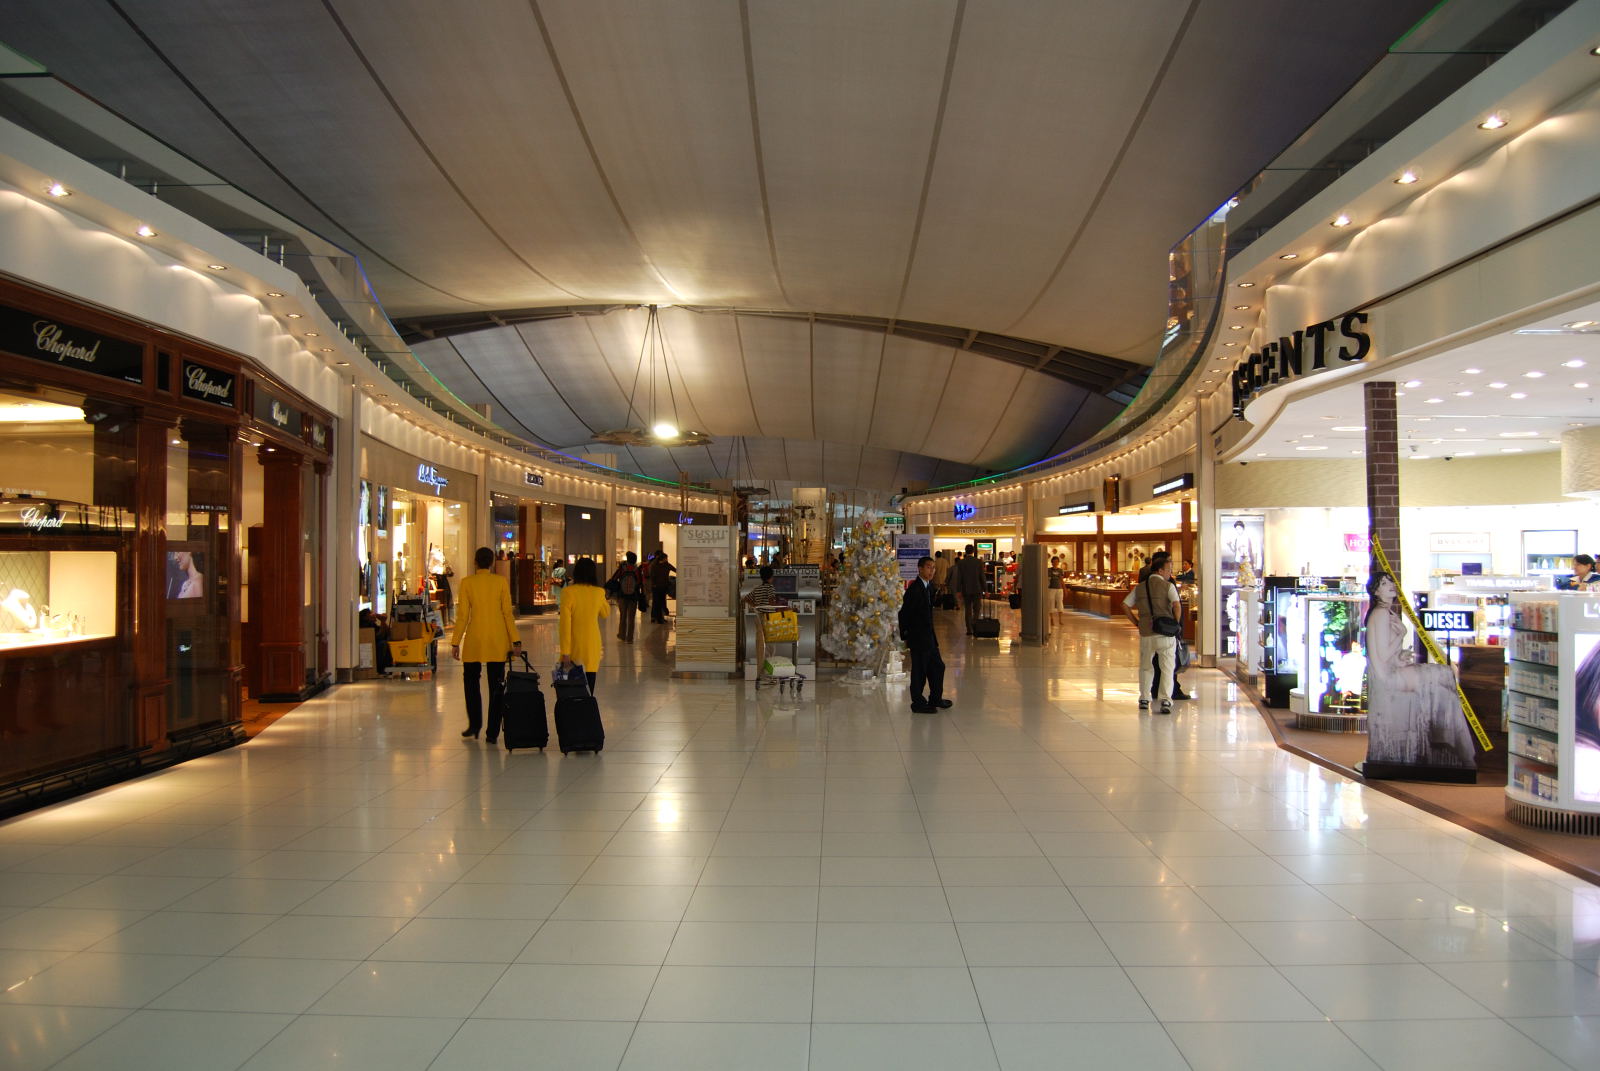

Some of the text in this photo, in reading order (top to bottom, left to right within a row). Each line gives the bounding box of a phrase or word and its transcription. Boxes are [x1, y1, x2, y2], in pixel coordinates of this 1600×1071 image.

[33, 321, 101, 362] Chopard
[186, 365, 232, 398] Chopard
[21, 507, 67, 531] Chopard
[1424, 612, 1469, 629] DIESEL
